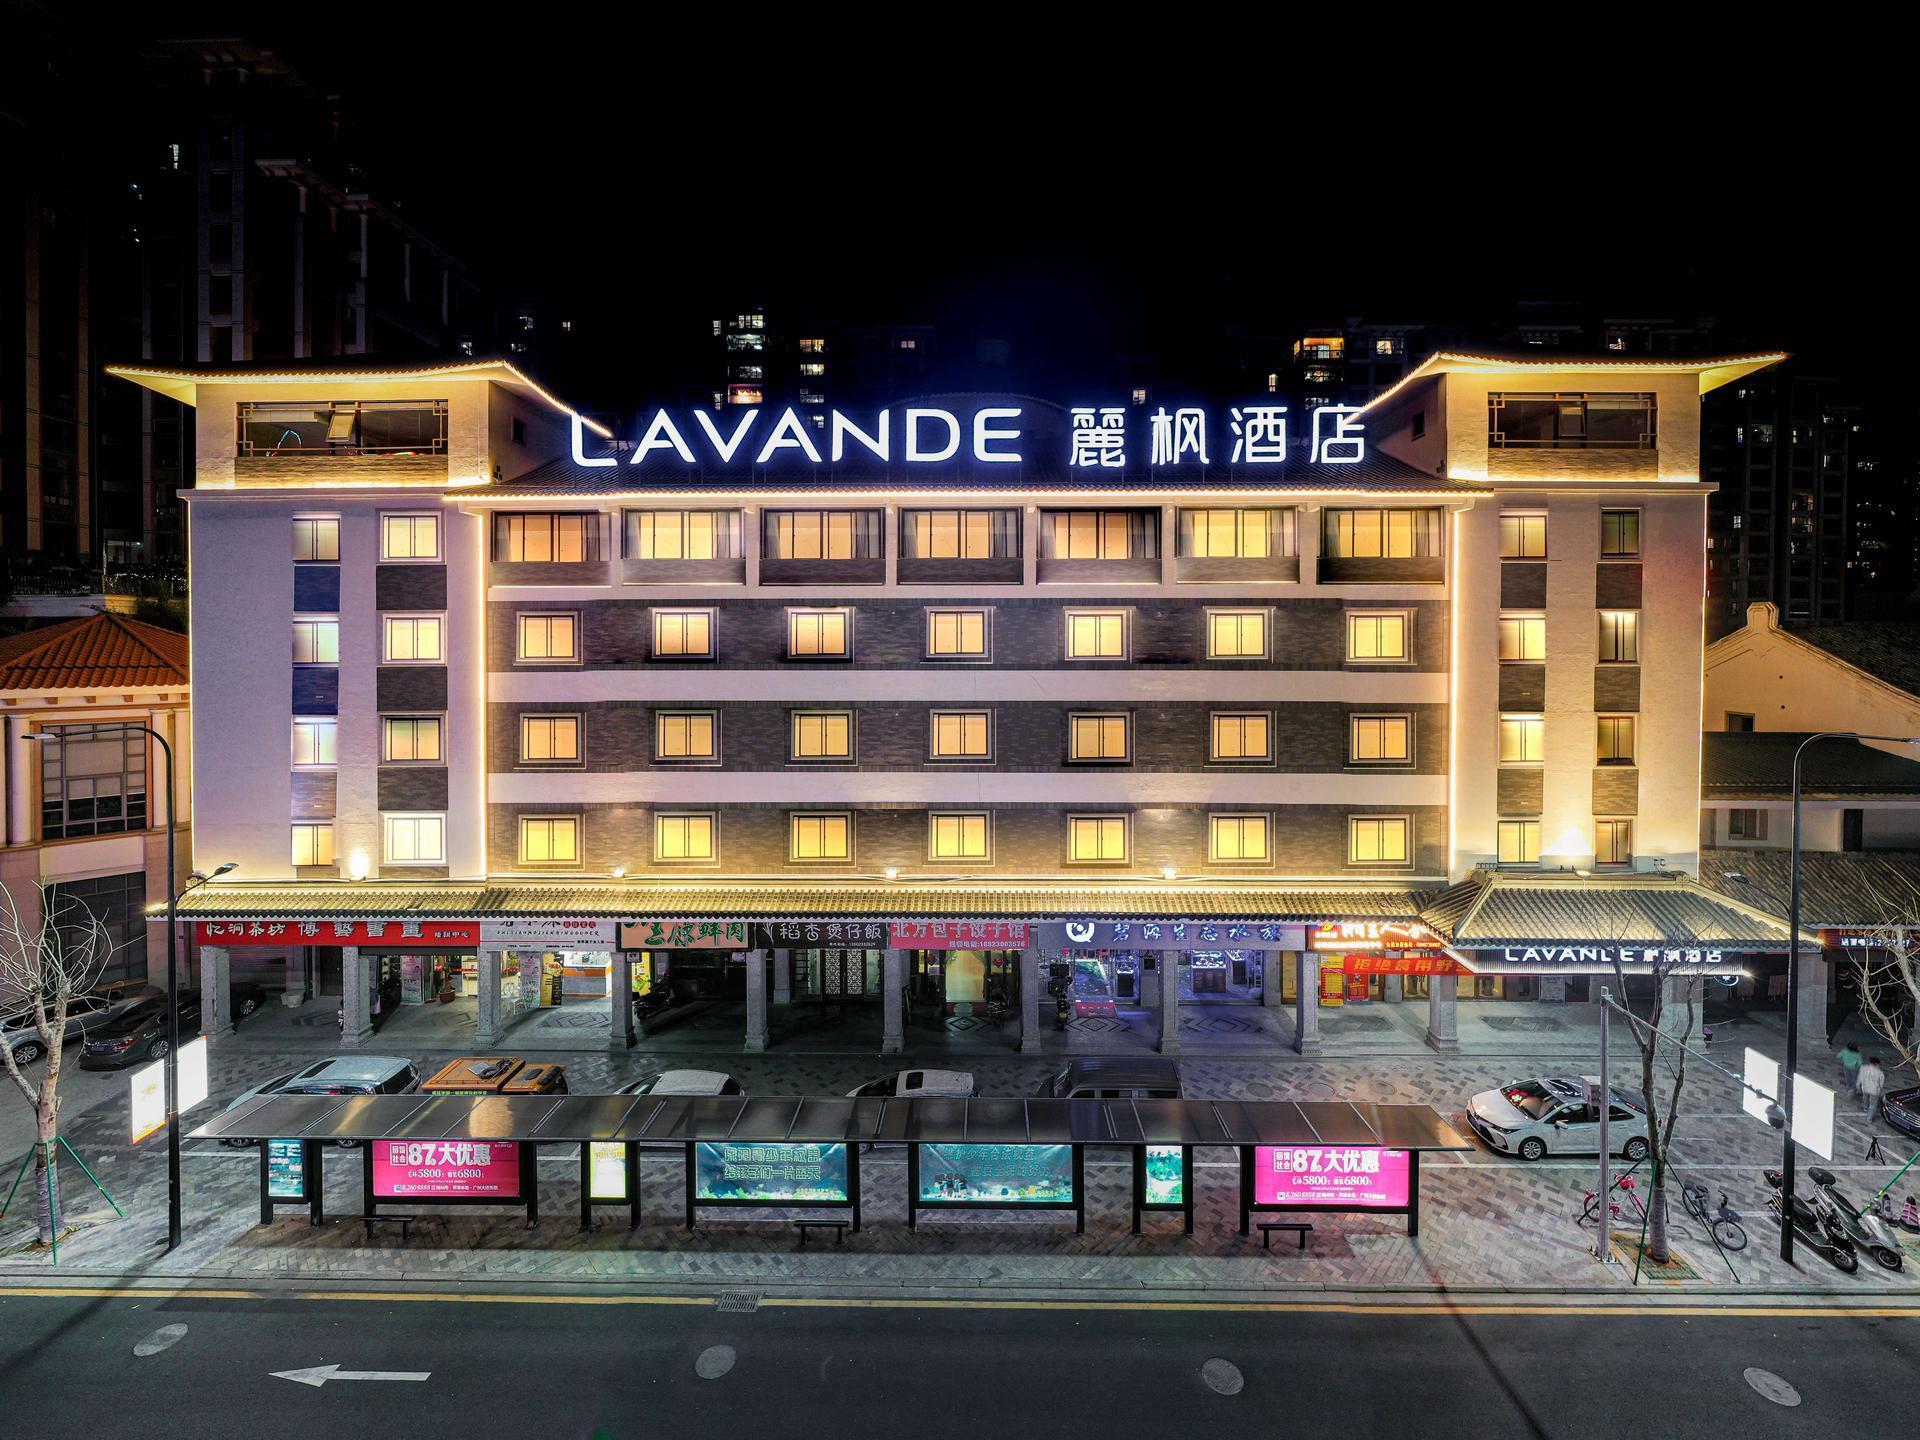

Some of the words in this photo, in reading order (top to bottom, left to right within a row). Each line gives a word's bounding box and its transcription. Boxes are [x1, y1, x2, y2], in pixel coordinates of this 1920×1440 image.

[571, 406, 1023, 467] LAVANDE
[1069, 403, 1366, 467] 麗枫酒店
[779, 923, 882, 941] 稻香煲仔飯
